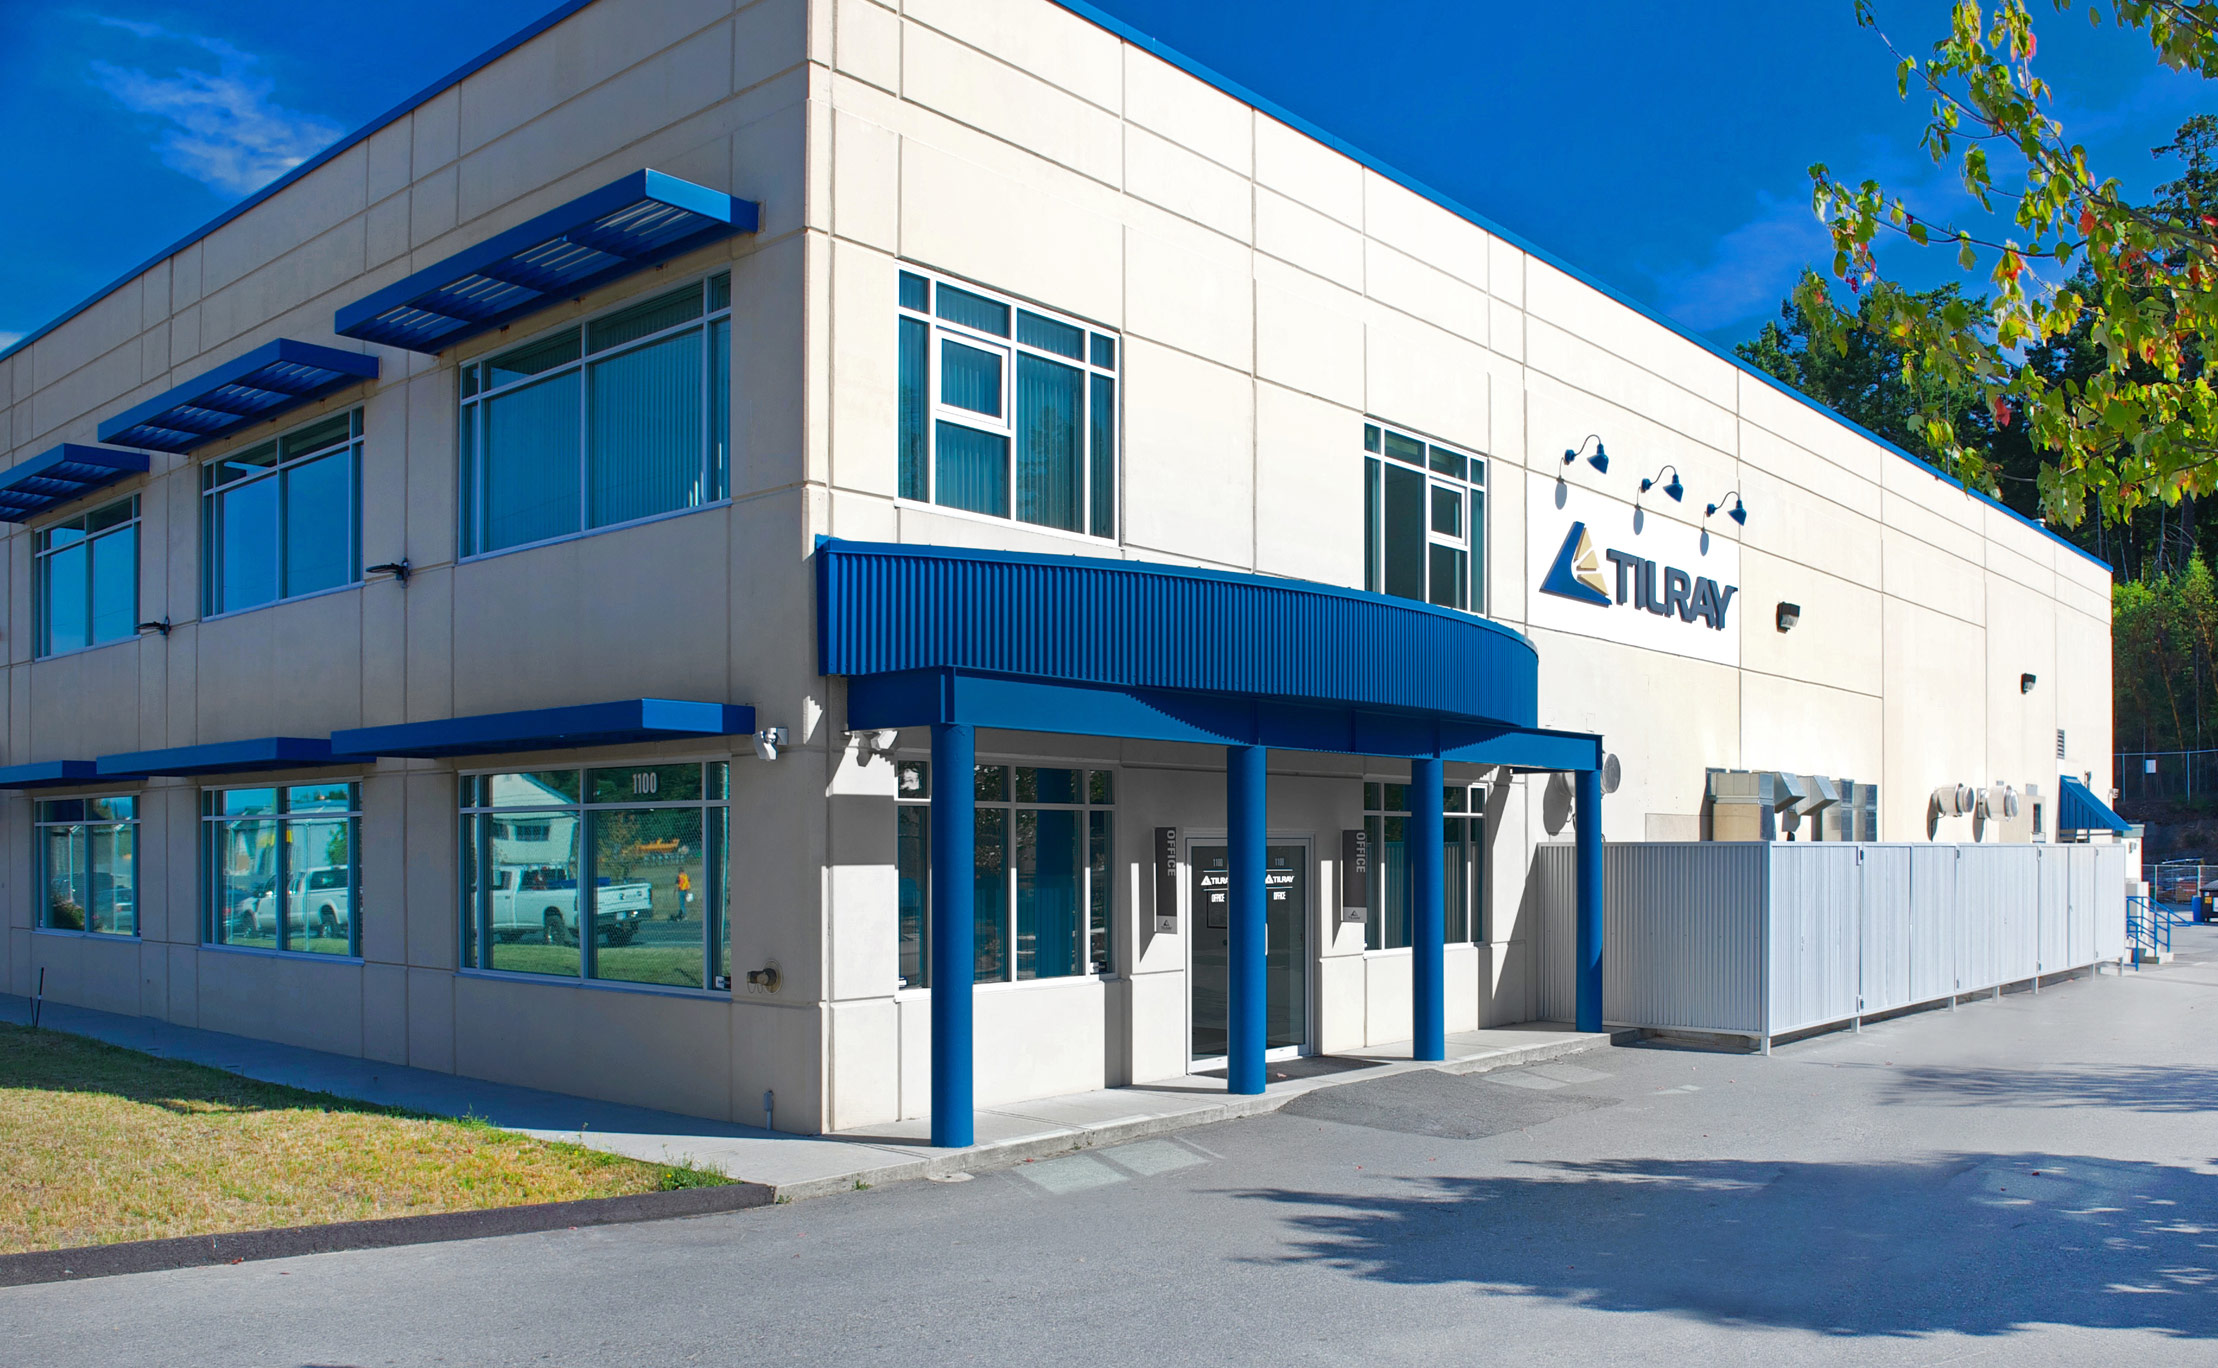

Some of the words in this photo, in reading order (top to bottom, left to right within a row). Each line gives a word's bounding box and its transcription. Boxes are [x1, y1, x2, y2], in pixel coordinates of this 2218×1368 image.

[1606, 548, 1738, 631] TILRAY
[632, 772, 657, 794] 1100
[1166, 830, 1176, 877] OFFICE
[1356, 832, 1366, 873] OFFICE
[1211, 877, 1228, 885] TILRA
[1273, 875, 1295, 883] TILRAY
